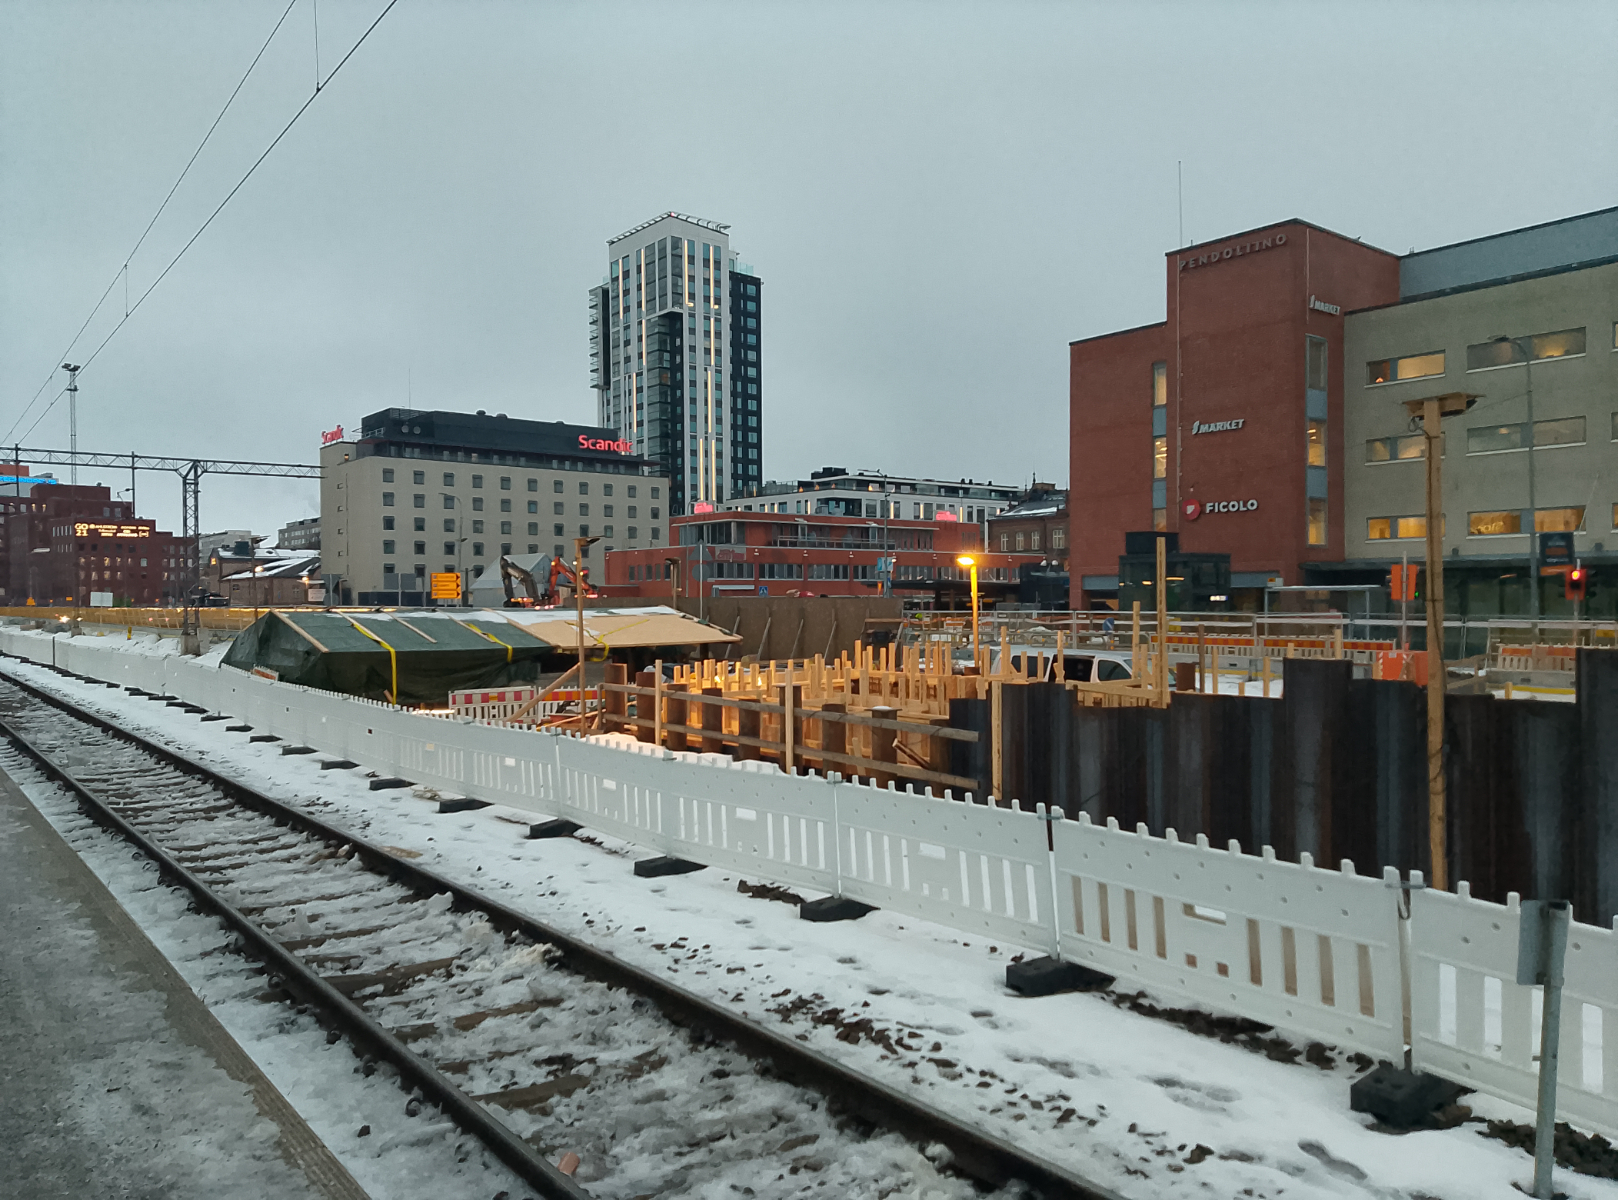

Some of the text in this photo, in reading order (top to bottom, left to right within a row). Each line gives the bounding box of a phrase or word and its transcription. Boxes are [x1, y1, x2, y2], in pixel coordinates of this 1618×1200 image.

[1198, 419, 1245, 434] MARKET
[578, 434, 634, 453] Scandic
[1205, 499, 1258, 514] FICOLO
[75, 529, 89, 537] 21
